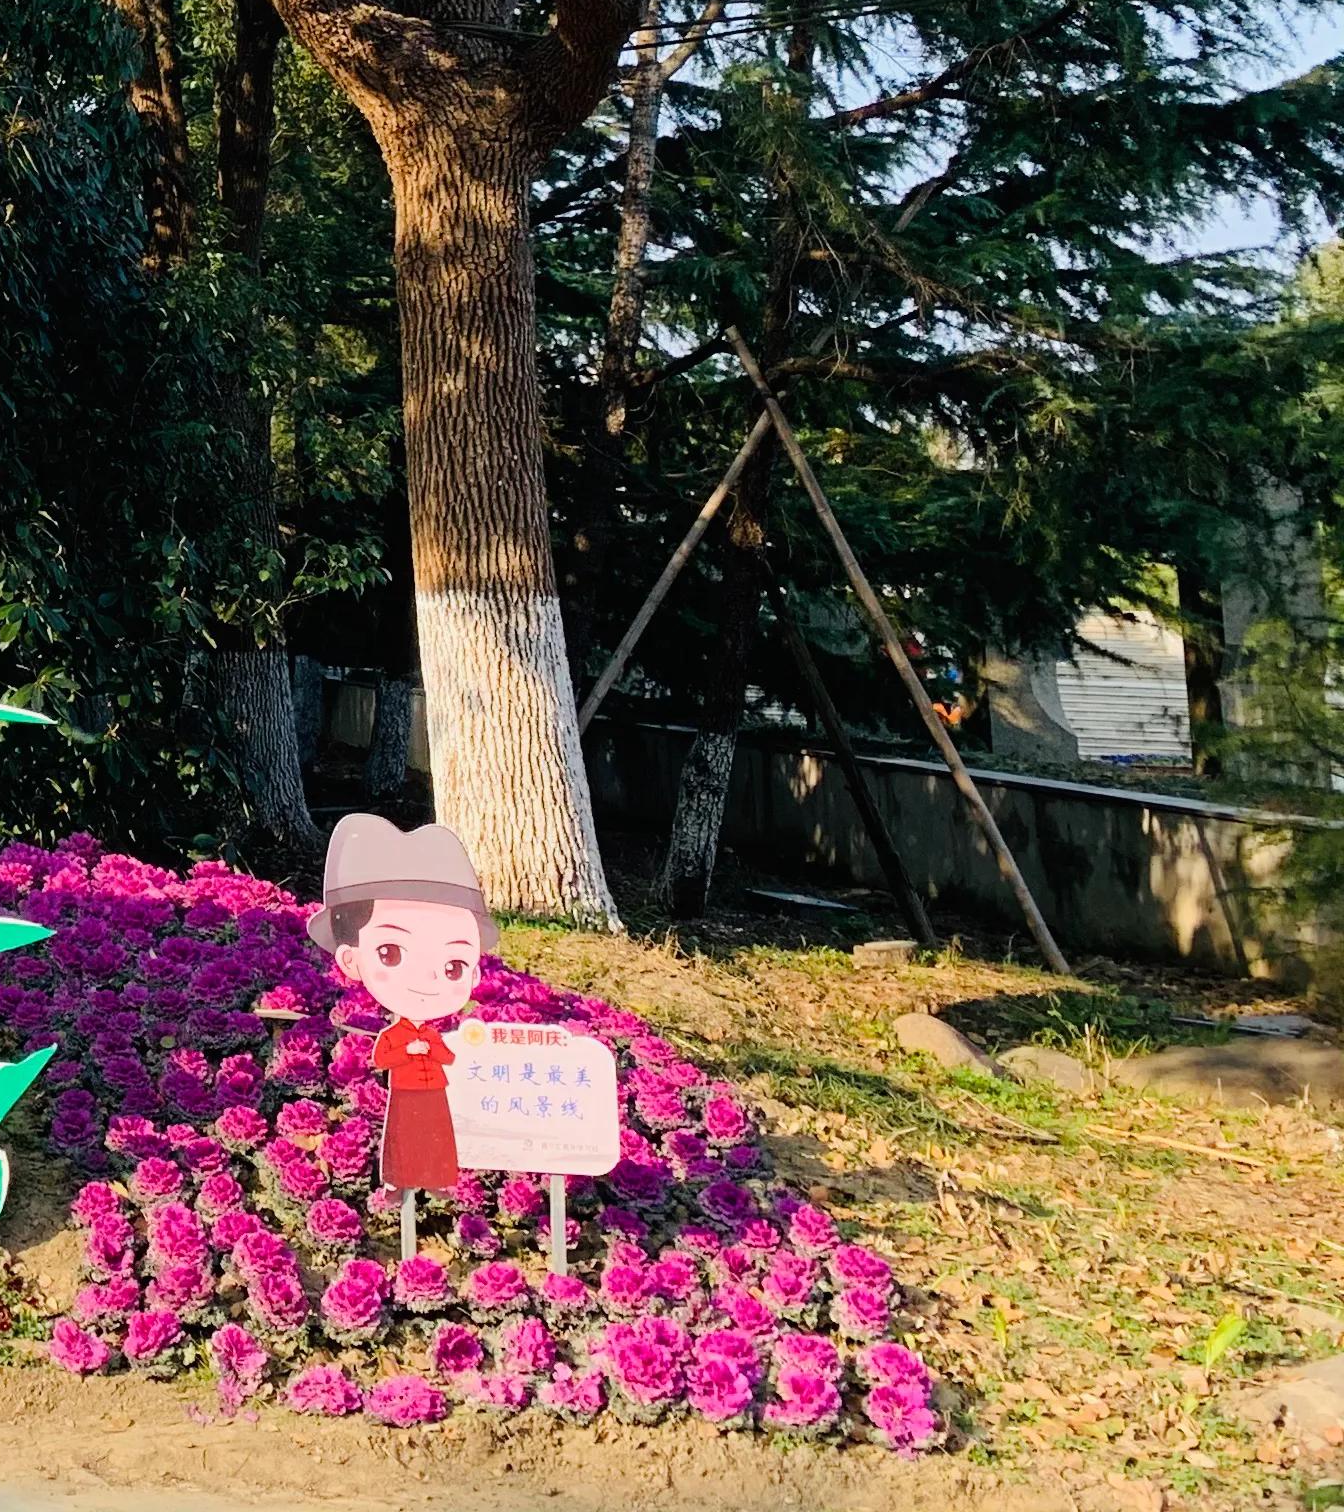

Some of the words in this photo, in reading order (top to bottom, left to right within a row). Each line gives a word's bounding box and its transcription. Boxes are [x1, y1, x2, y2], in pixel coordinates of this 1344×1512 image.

[466, 1061, 592, 1088] 文明是最美
[480, 1095, 584, 1121] 的风景线
